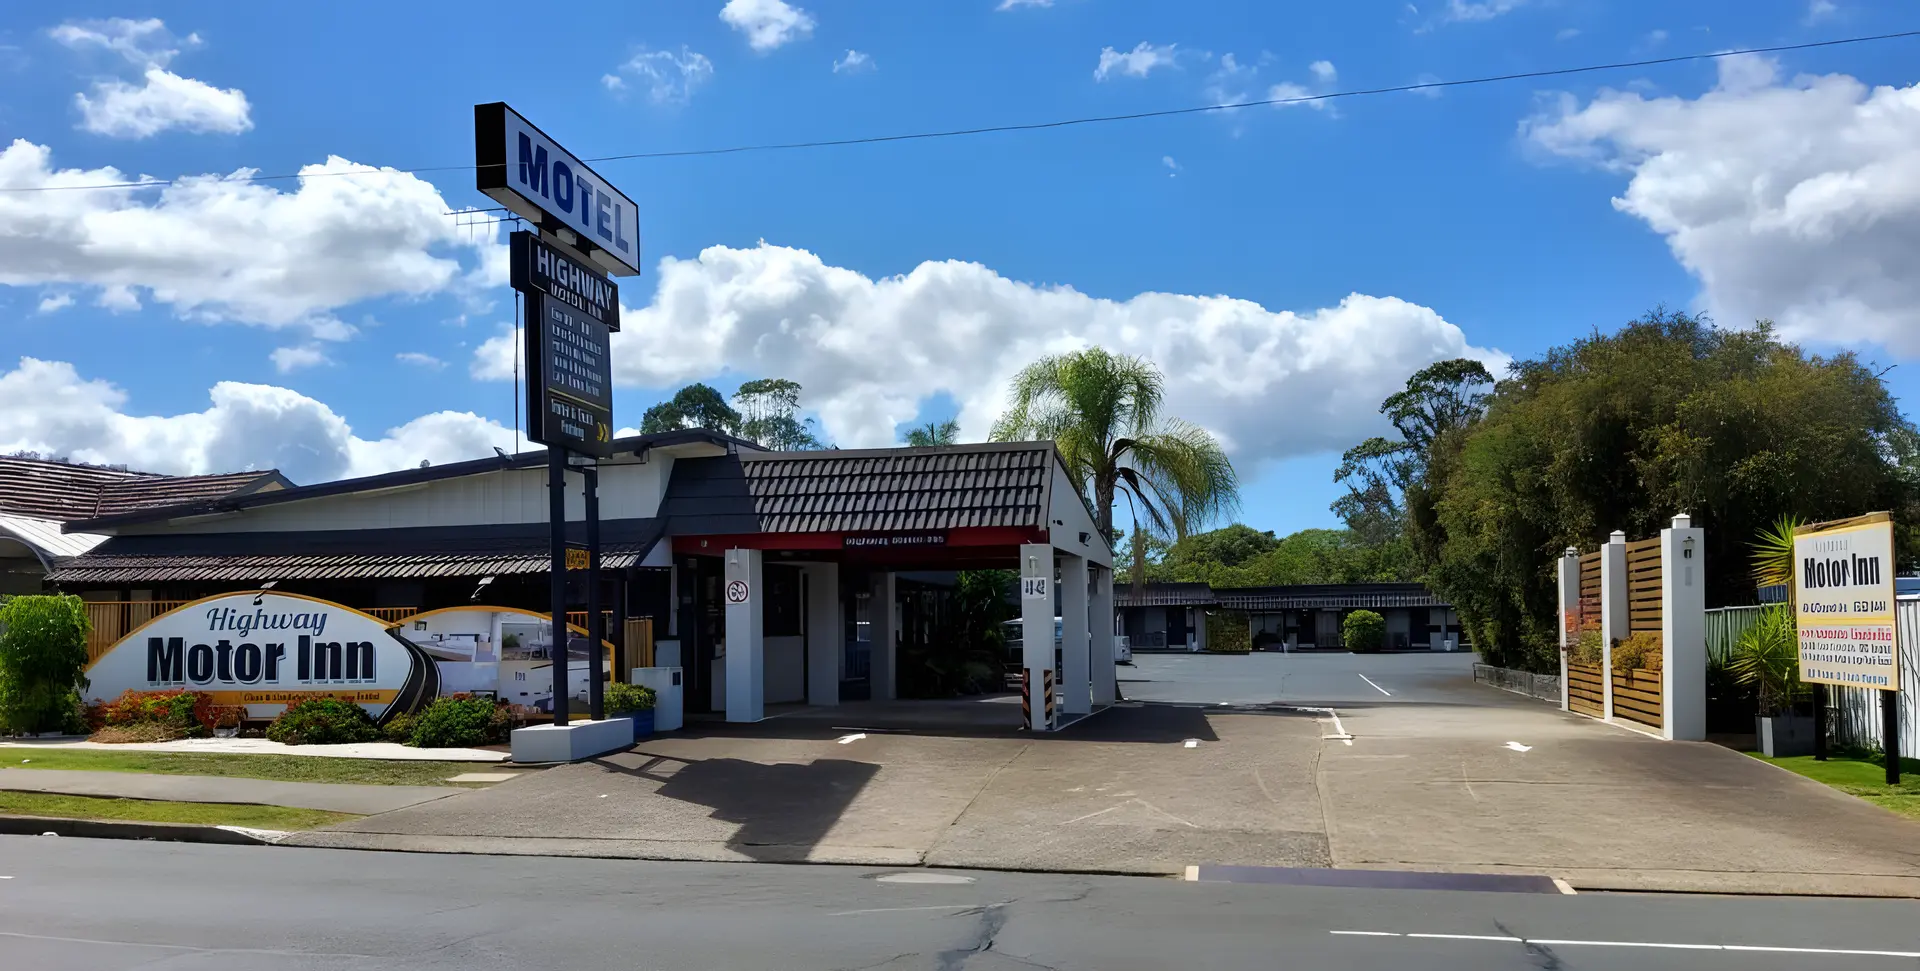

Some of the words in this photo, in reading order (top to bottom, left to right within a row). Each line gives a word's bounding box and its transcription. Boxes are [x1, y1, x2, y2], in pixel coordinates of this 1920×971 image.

[518, 131, 629, 254] MOTEL
[537, 245, 612, 311] HIGHWAY
[1804, 557, 1851, 589] Motor
[1852, 553, 1881, 586] Inn
[206, 607, 328, 638] Highway
[146, 636, 287, 686] Motor
[297, 635, 377, 685] Inn
